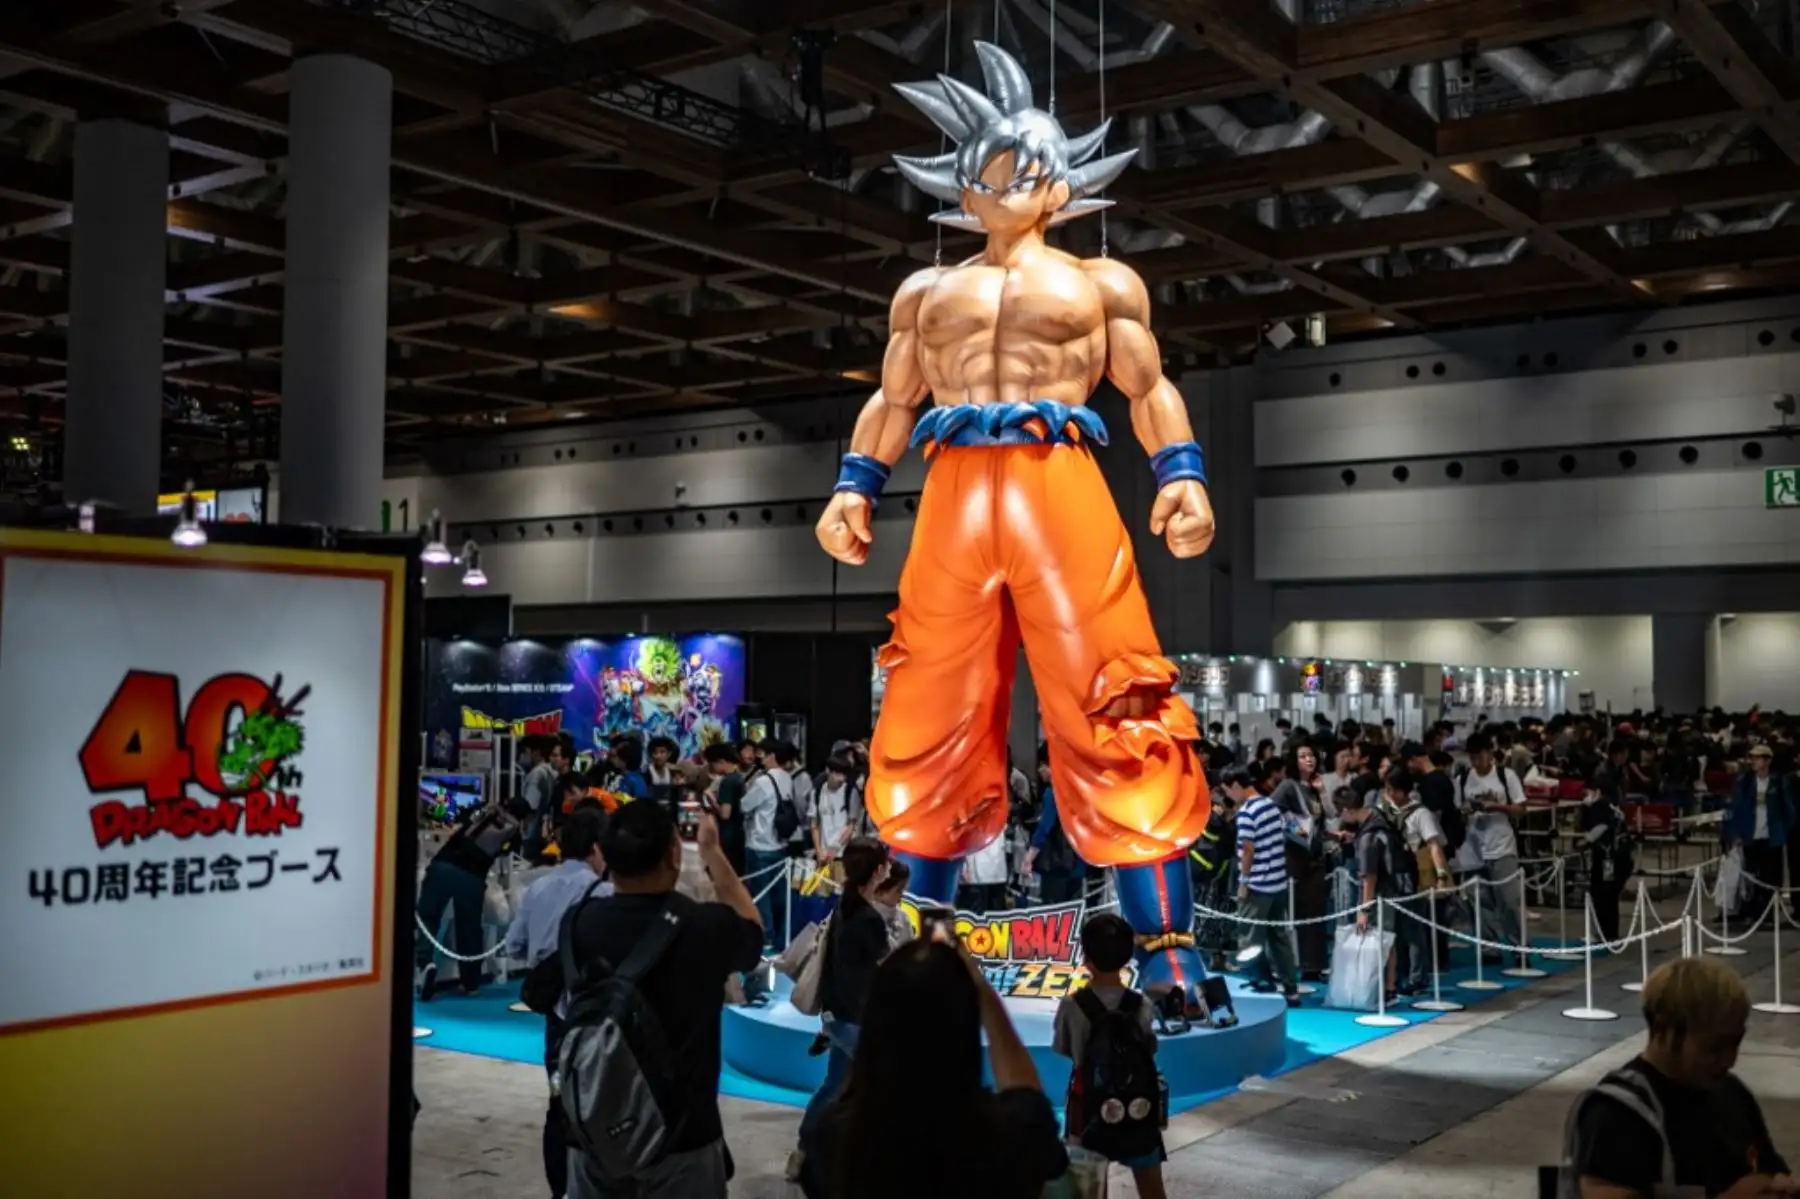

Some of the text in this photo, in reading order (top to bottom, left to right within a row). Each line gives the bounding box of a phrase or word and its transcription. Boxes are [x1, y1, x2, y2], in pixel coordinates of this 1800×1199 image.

[90, 797, 244, 848] DRAGON
[29, 848, 342, 907] 40周年記念ブース
[1011, 911, 1076, 960] BALL
